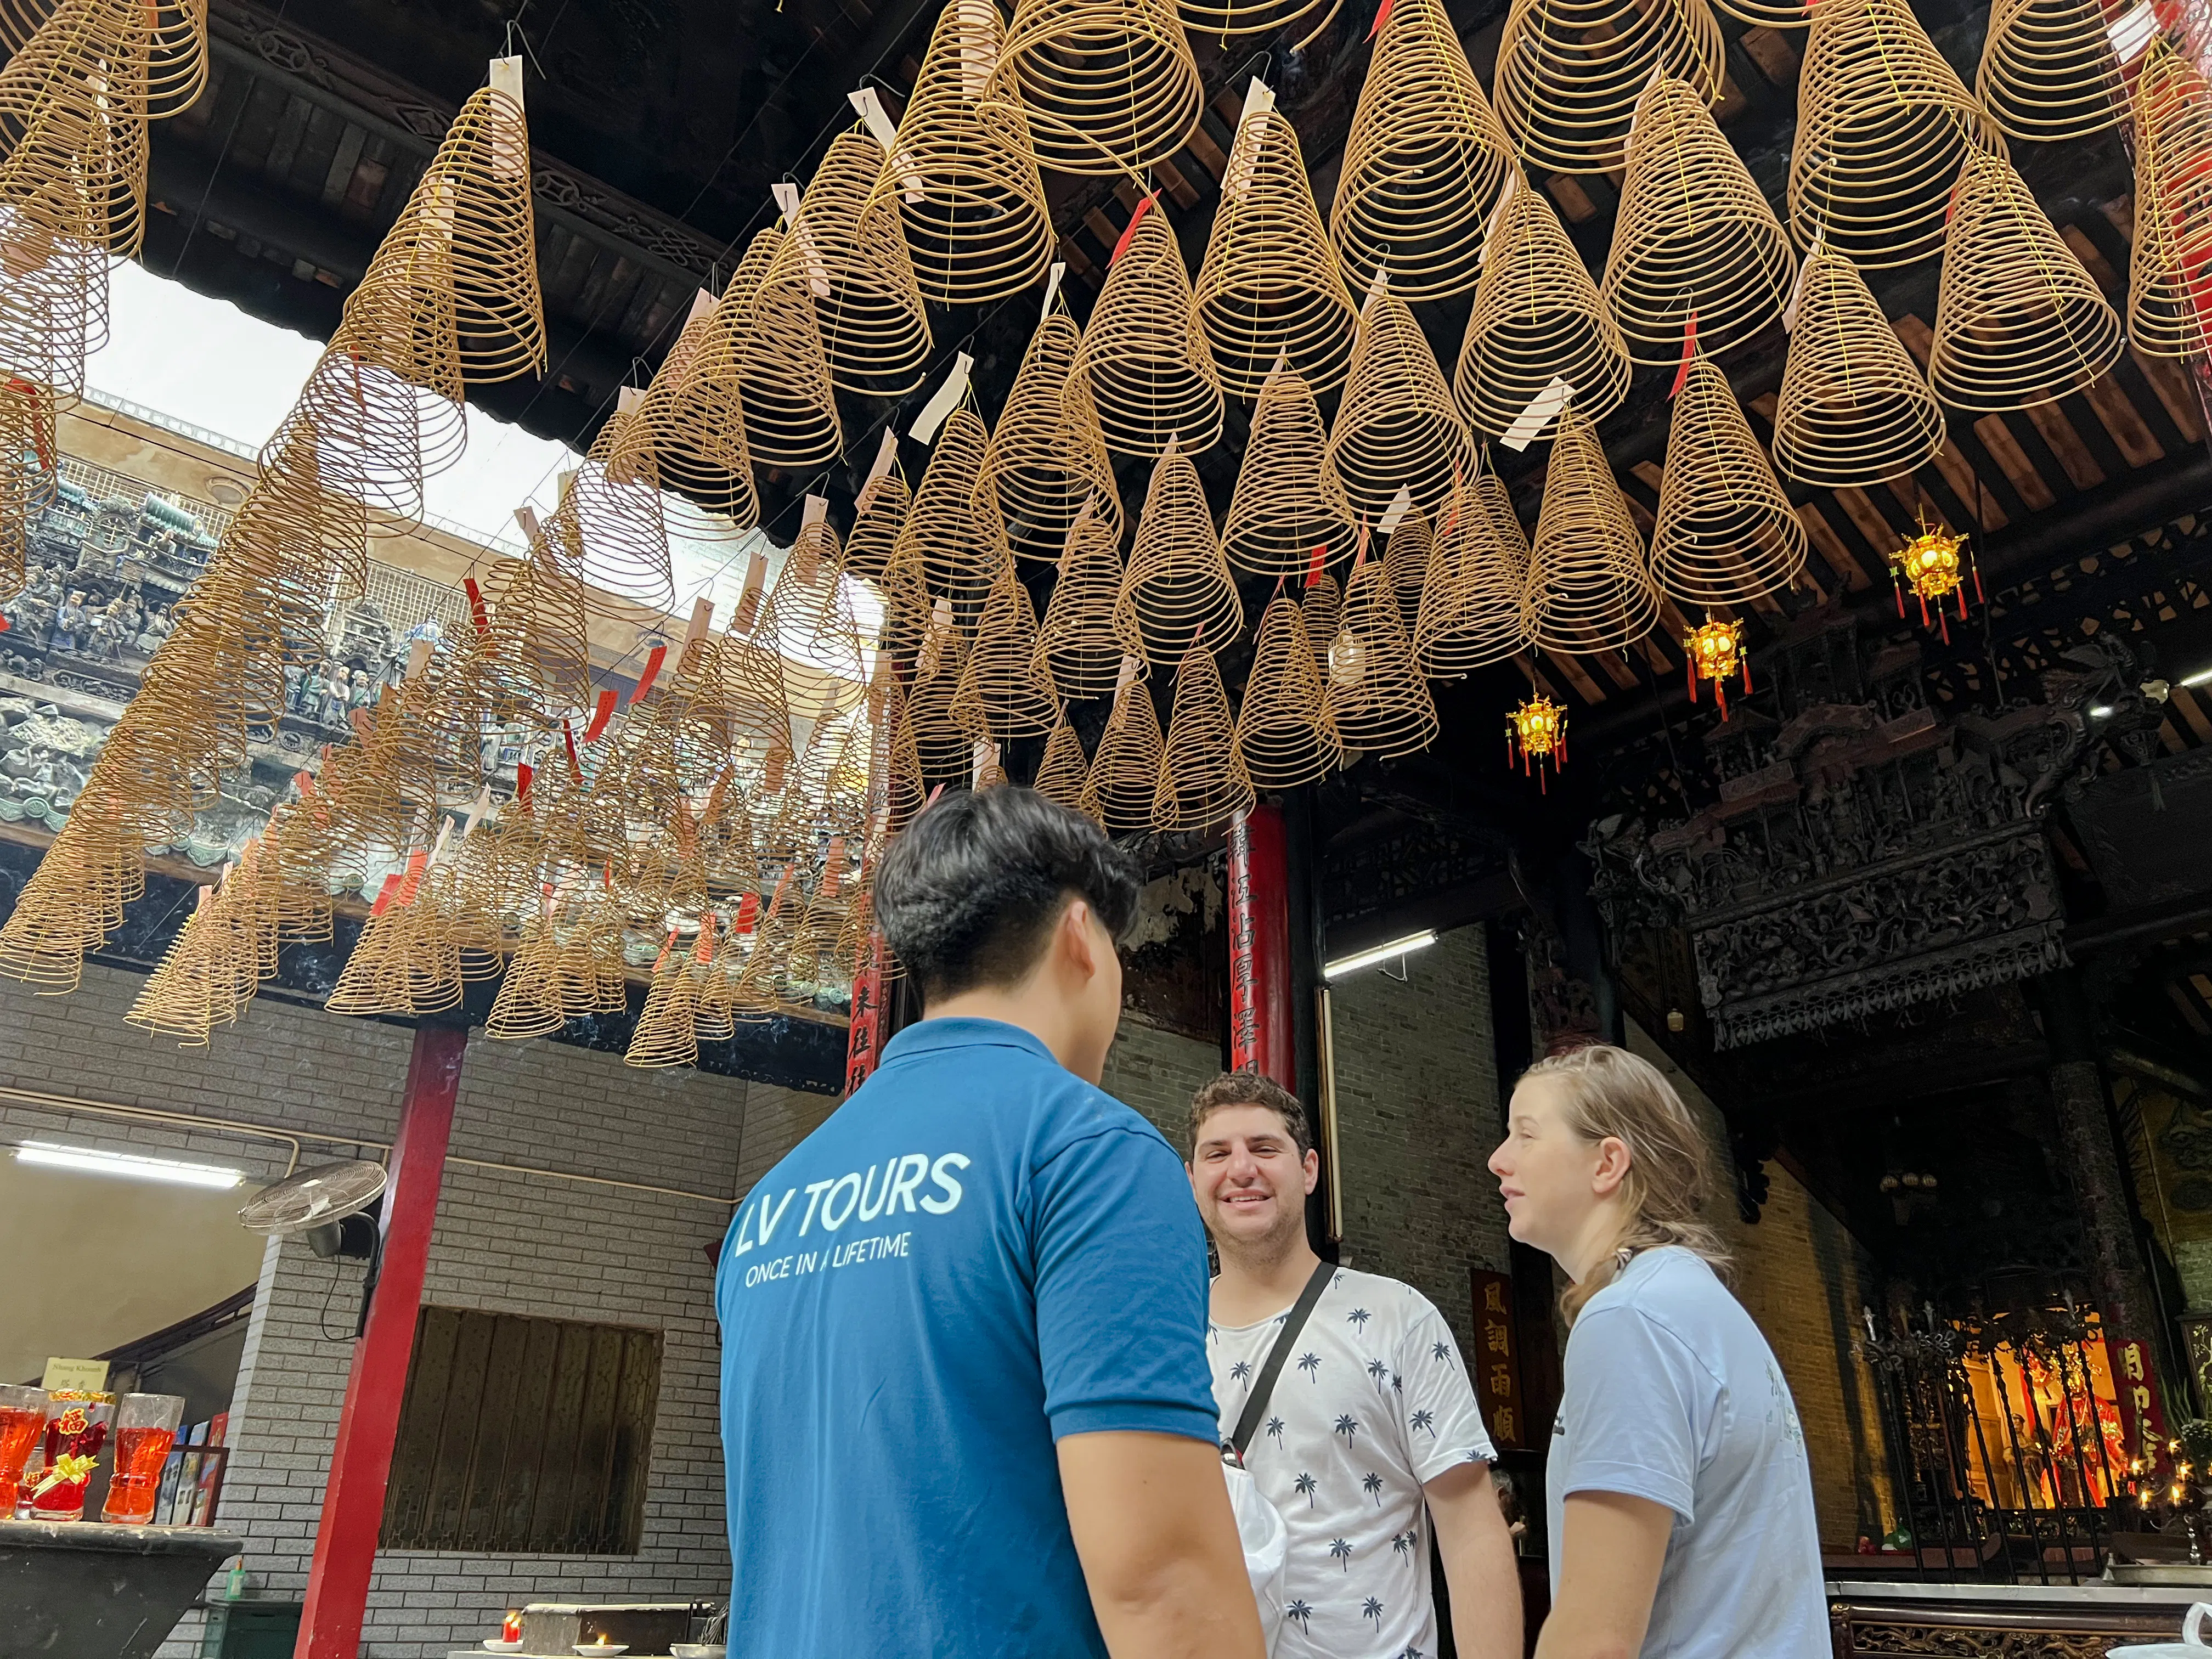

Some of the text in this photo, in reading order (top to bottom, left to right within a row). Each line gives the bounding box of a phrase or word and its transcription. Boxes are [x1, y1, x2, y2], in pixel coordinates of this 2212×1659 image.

[735, 1152, 971, 1257] LV TOURS
[746, 1255, 793, 1288] ONCE
[795, 1251, 817, 1275] IN
[832, 1232, 911, 1268] LIFETIME
